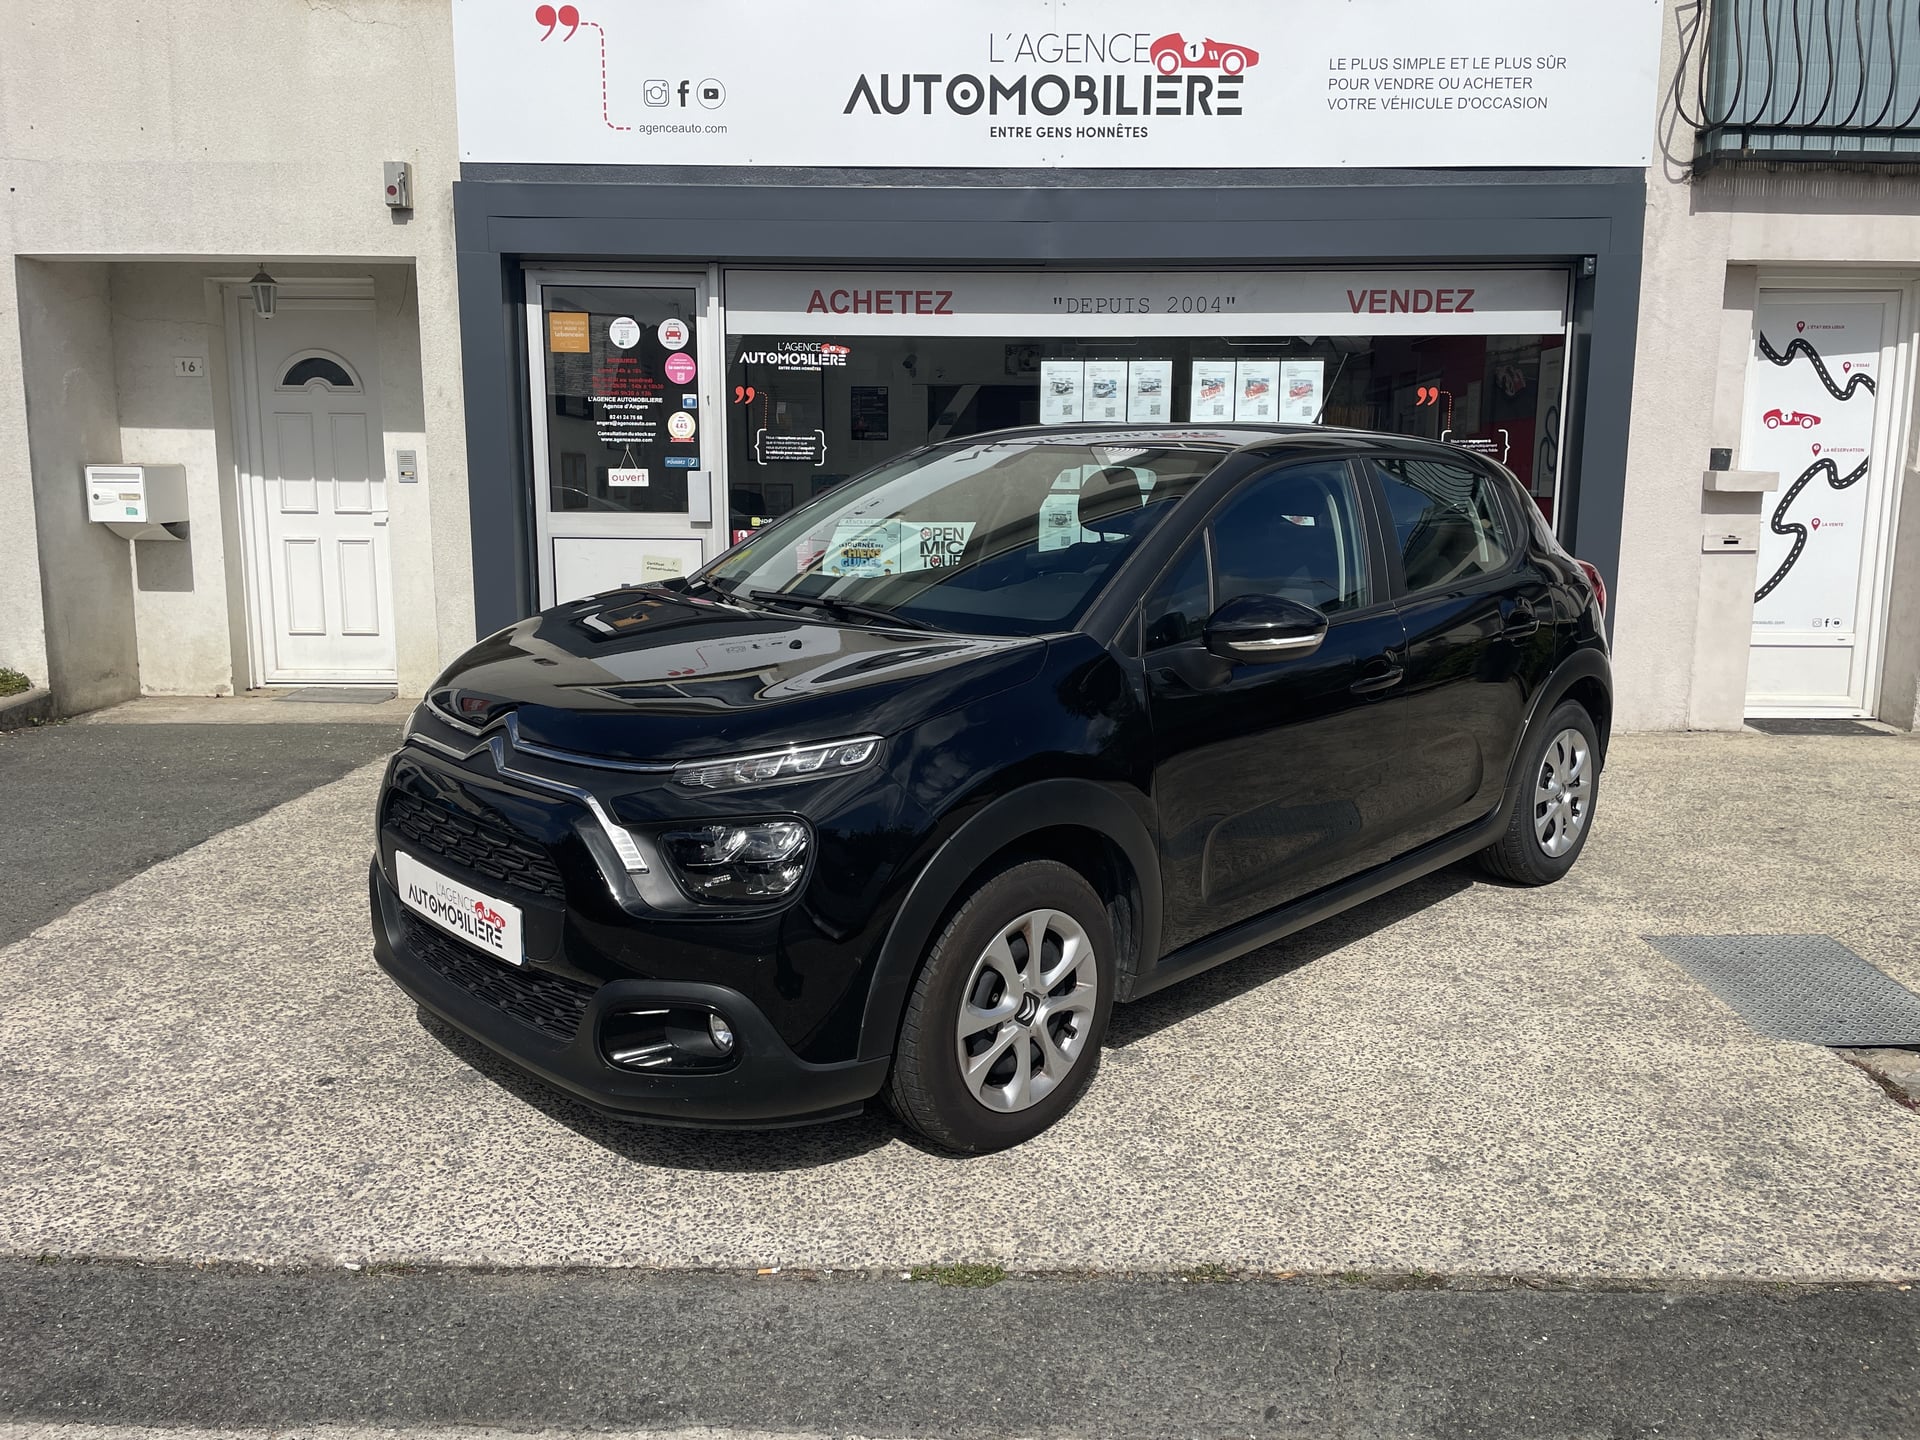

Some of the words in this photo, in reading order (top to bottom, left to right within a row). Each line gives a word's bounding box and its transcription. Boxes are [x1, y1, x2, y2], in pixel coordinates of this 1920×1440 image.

[989, 32, 1151, 63] L'AGENCE
[1329, 58, 1347, 71] LE
[1350, 58, 1389, 70] PLUS
[1392, 57, 1446, 70] SIMPLE
[1449, 57, 1469, 69] ET
[1472, 57, 1490, 69] LE
[1494, 57, 1532, 69] PLUS
[1536, 54, 1567, 70] SÛR
[1328, 77, 1370, 91] POUR
[1374, 77, 1434, 90] VENDRE
[1438, 77, 1460, 90] OU
[1462, 77, 1533, 90] ACHETER
[1327, 97, 1377, 110] VOTRE
[1381, 95, 1454, 110] VÉHICULE
[1457, 96, 1548, 110] D'OCCASION
[638, 123, 728, 135] agenceauto.com
[989, 125, 1032, 138] ENTRE
[1036, 125, 1073, 138] GENS
[1075, 123, 1149, 139] HONNÊTES
[806, 290, 954, 315] ACHETEZ
[1347, 289, 1476, 314] VENDEZ
[777, 342, 822, 352] L'AGENCE
[739, 351, 847, 366] AUTOMOBILIERE
[181, 361, 196, 372] 16
[611, 473, 645, 482] ouvert
[920, 526, 964, 541] OPEN
[920, 541, 965, 554] MIC
[408, 883, 503, 950] AUTOMOBILIERE
